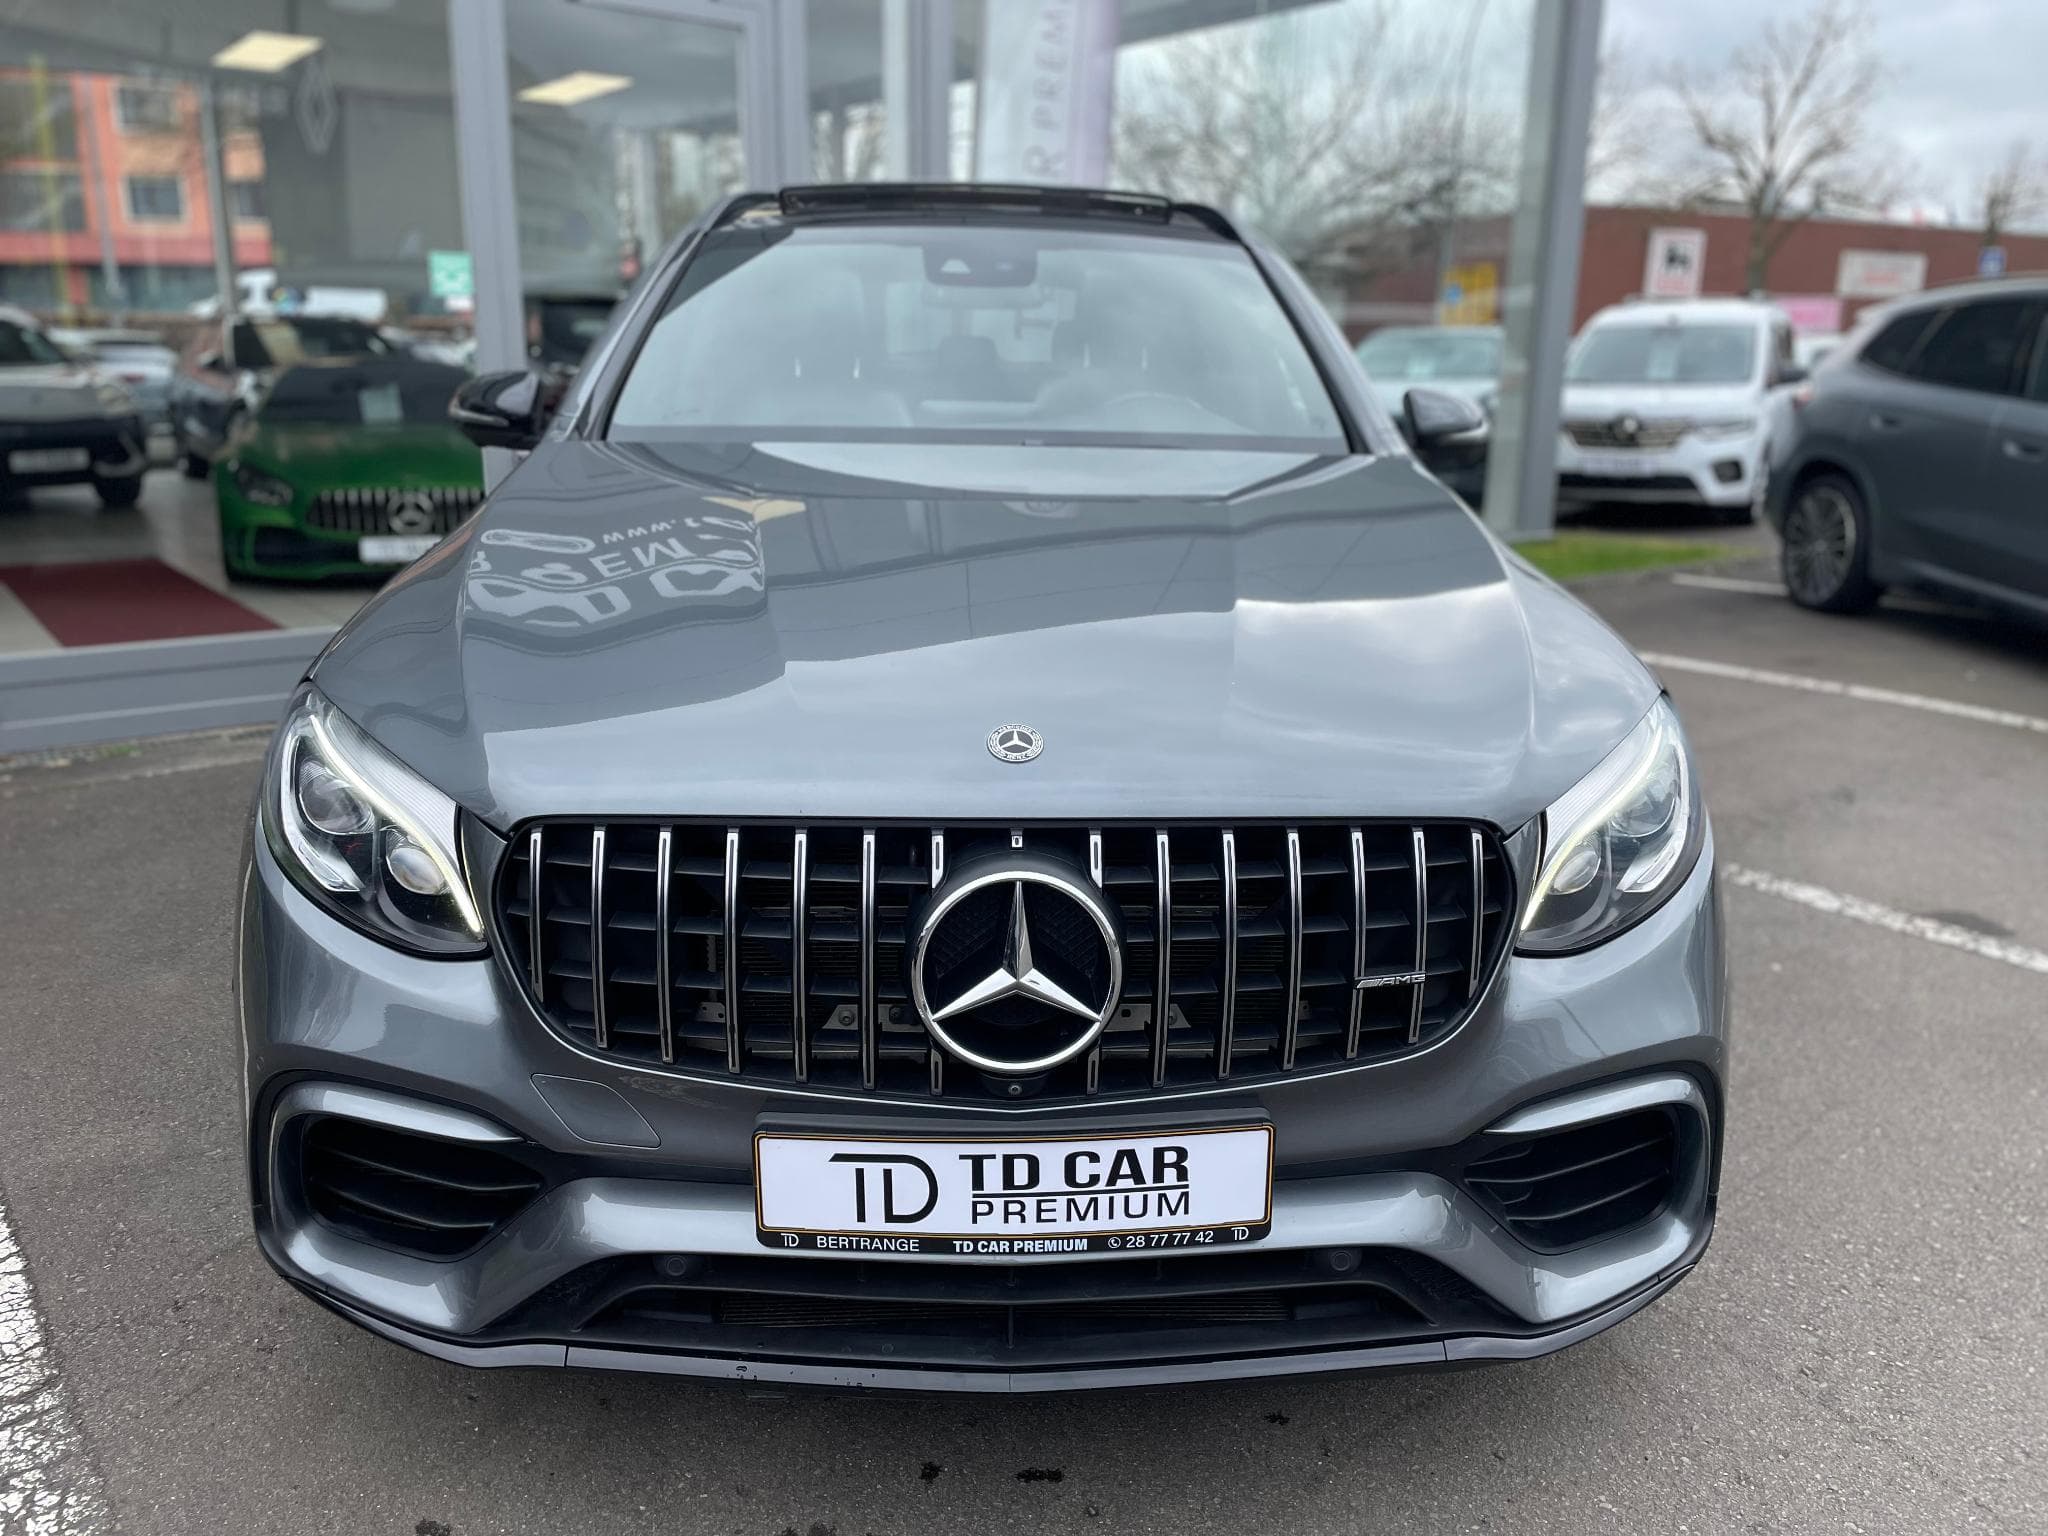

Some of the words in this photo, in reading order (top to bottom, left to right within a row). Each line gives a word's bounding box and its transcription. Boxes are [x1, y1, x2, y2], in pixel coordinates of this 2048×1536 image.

[1030, 0, 1070, 132] PREM
[1376, 974, 1426, 988] AMG
[828, 1152, 939, 1224] TD
[958, 1153, 1040, 1191] TD
[1064, 1146, 1189, 1189] CAR
[971, 1191, 1190, 1224] PREMIUM
[780, 1233, 799, 1247] TD
[816, 1235, 920, 1252] BERTRANGE
[953, 1240, 974, 1253] TD
[977, 1240, 1010, 1253] CAR
[1013, 1238, 1088, 1253] PREMIUM
[1126, 1235, 1146, 1248] 28
[1150, 1233, 1168, 1247] 77
[1172, 1232, 1191, 1246] 77
[1195, 1230, 1214, 1243] 42
[1231, 1227, 1249, 1241] TD
